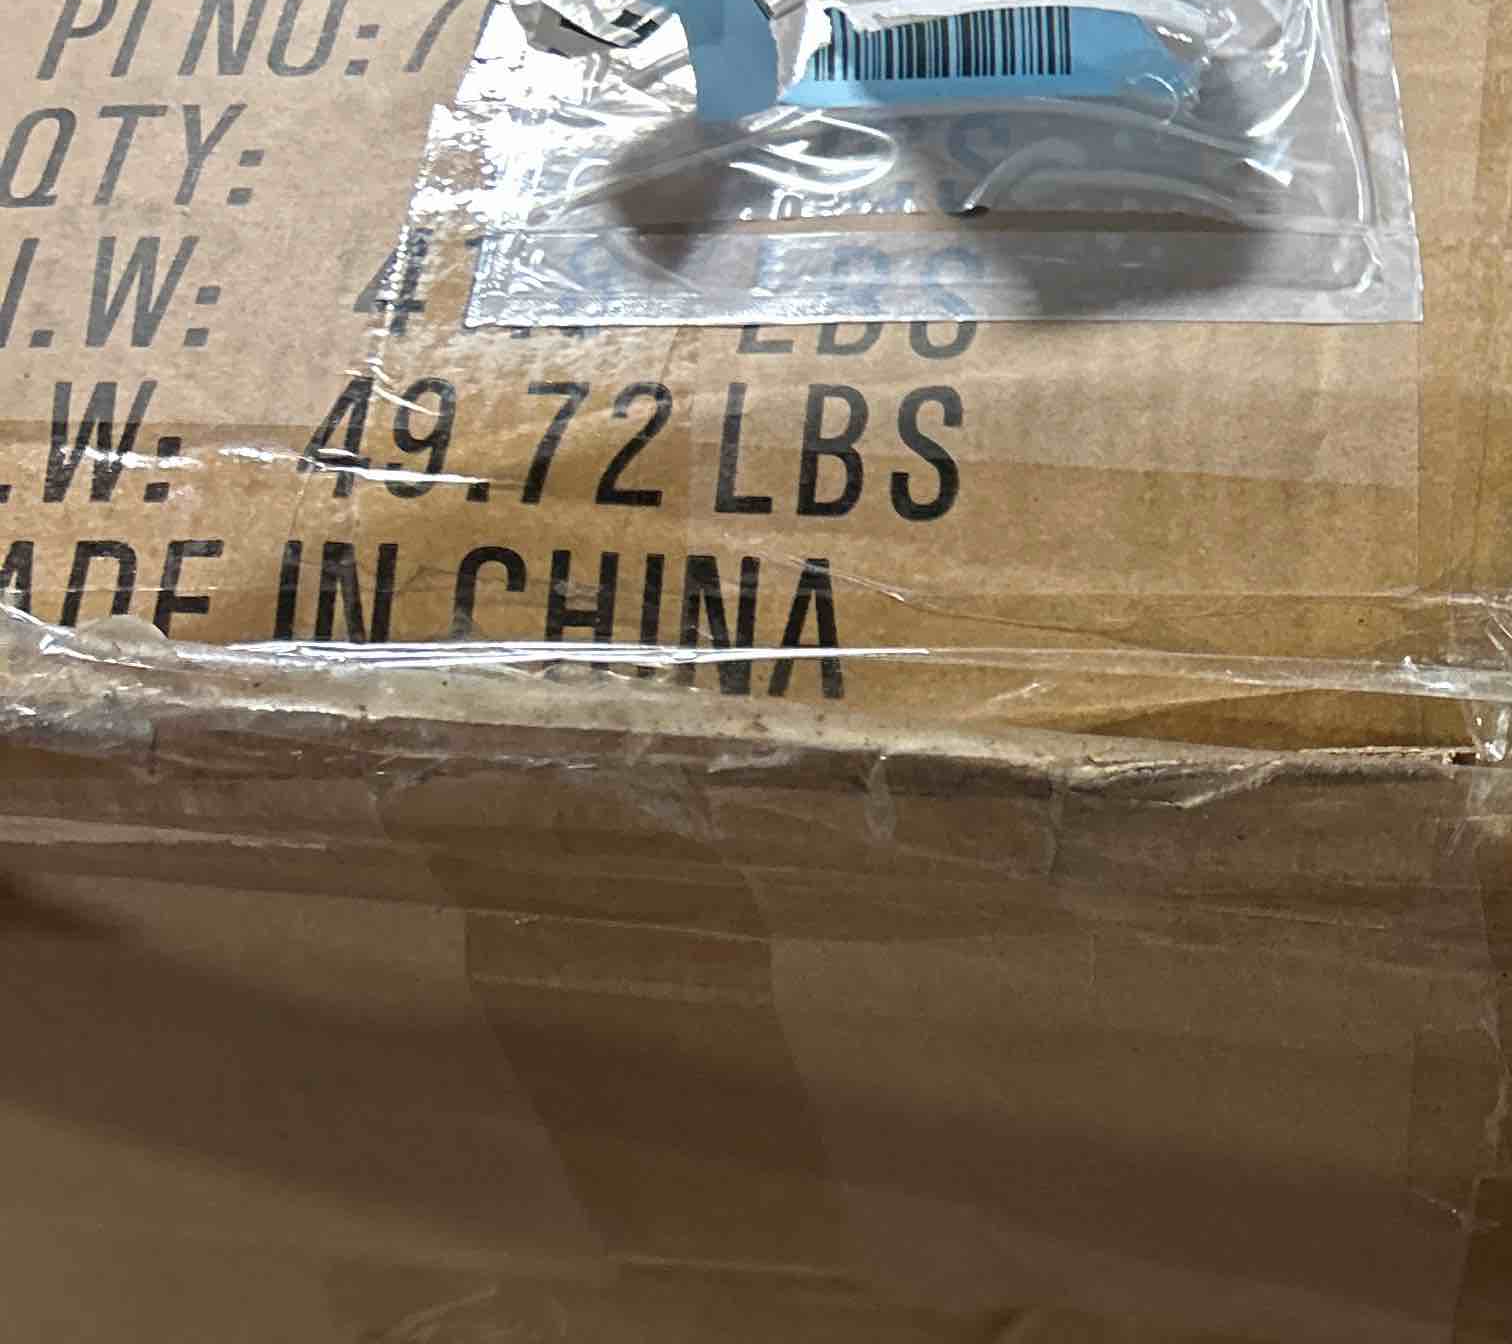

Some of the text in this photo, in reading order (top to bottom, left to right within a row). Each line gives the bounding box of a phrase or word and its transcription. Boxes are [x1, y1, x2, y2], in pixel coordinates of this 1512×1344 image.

[0, 104, 265, 209] QTY:
[737, 241, 986, 359] LBS
[303, 370, 674, 509] 49.72
[714, 382, 966, 522] LBS
[0, 540, 846, 701] ADE IN CHINA
